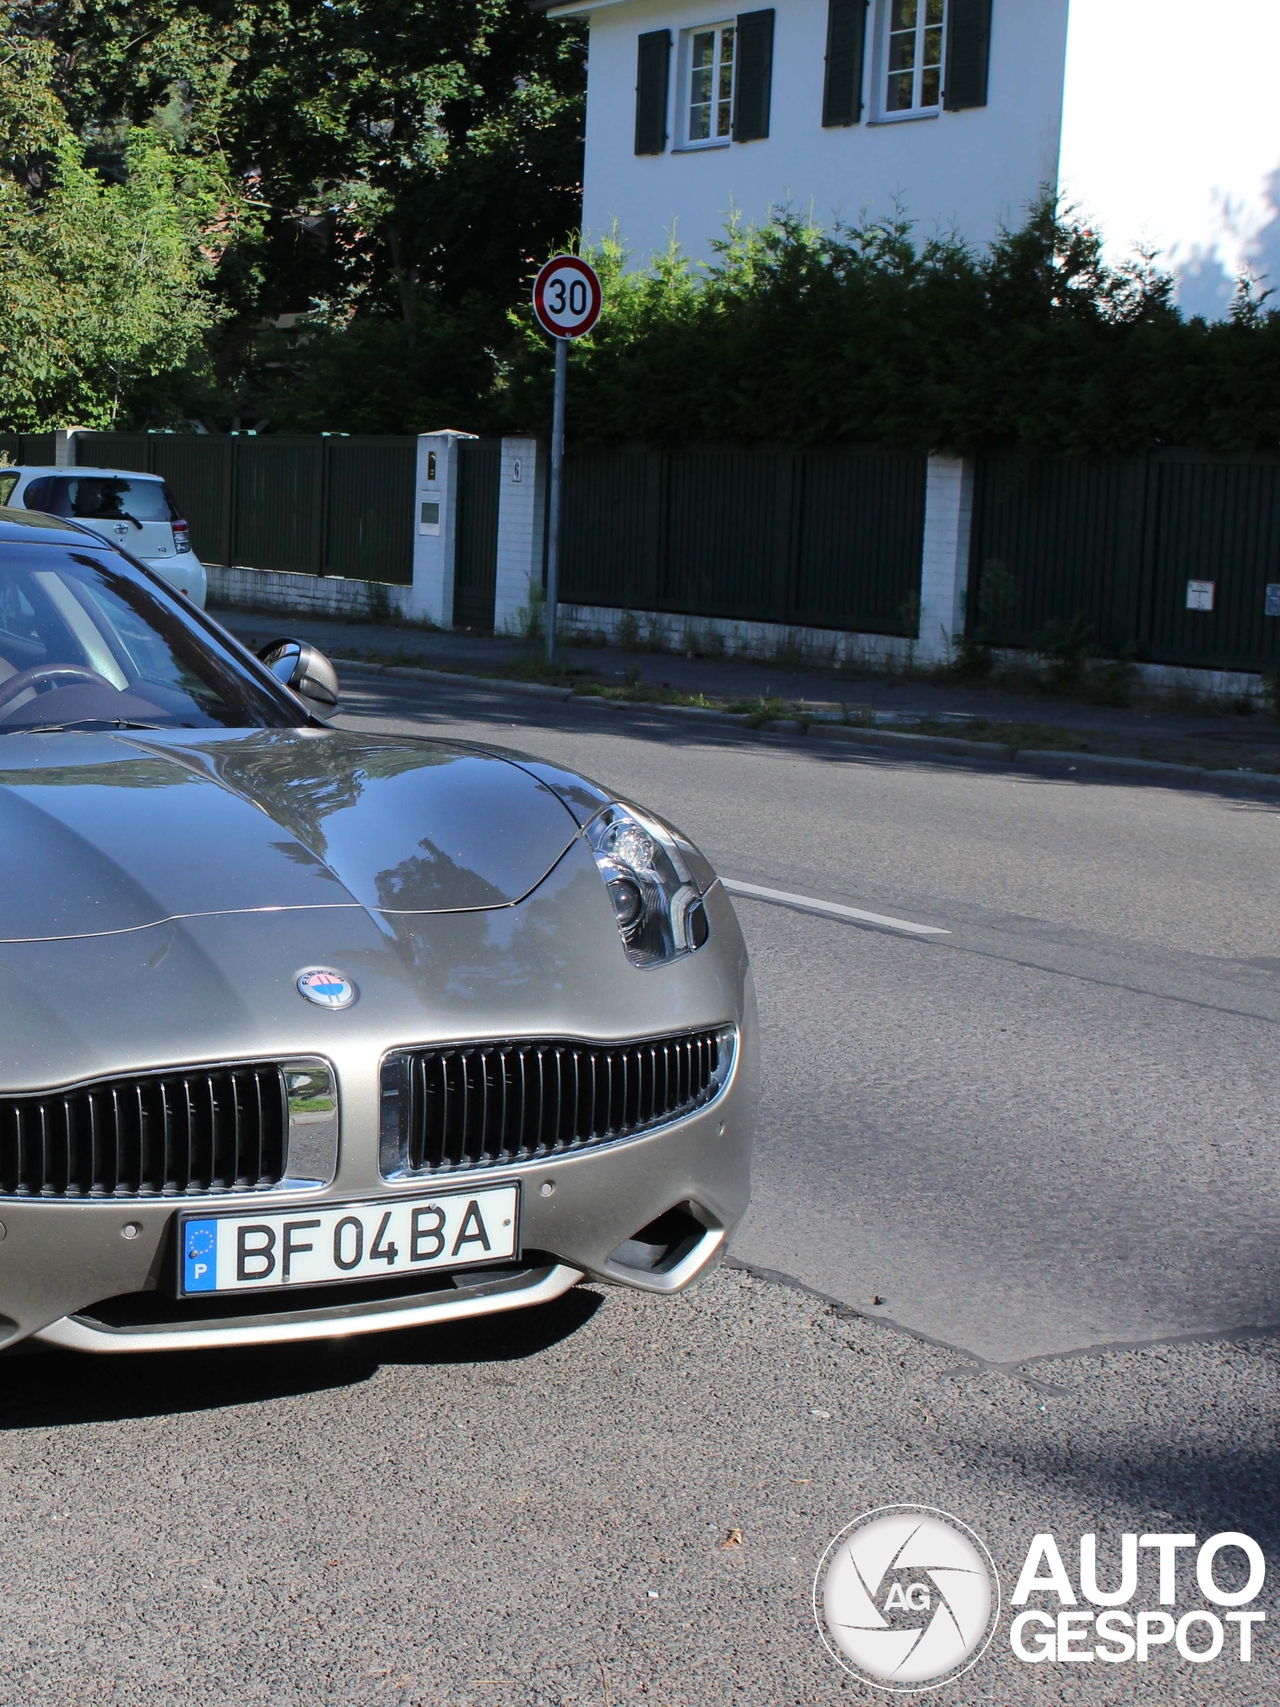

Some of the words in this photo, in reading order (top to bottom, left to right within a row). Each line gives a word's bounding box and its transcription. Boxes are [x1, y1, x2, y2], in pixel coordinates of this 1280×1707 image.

[549, 279, 587, 315] 30
[195, 1263, 208, 1279] P
[237, 1219, 321, 1282] BF
[410, 1200, 491, 1263] BA
